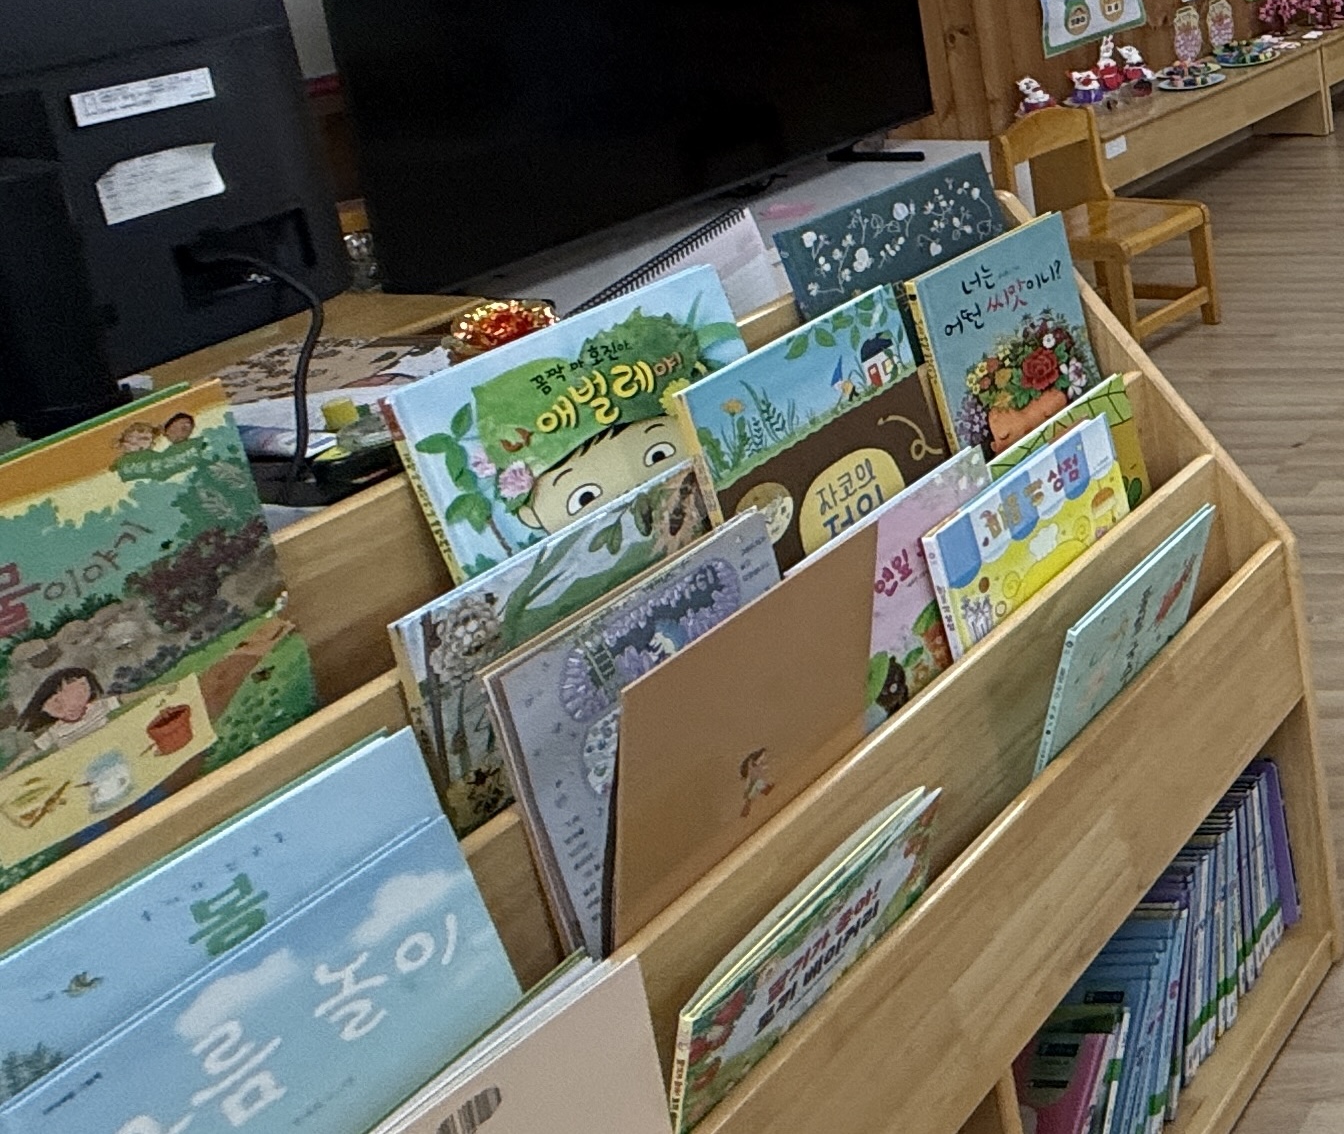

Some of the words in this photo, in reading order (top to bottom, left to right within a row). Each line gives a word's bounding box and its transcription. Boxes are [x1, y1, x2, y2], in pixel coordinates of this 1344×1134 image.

[961, 264, 996, 295] 너는
[944, 302, 985, 336] 어떤
[529, 364, 567, 395] 꼼짝
[569, 359, 585, 373] 마
[587, 340, 634, 366] 호진아
[815, 458, 877, 516] 자코의
[44, 520, 154, 601] 이야기
[314, 912, 458, 1042] 놀이
